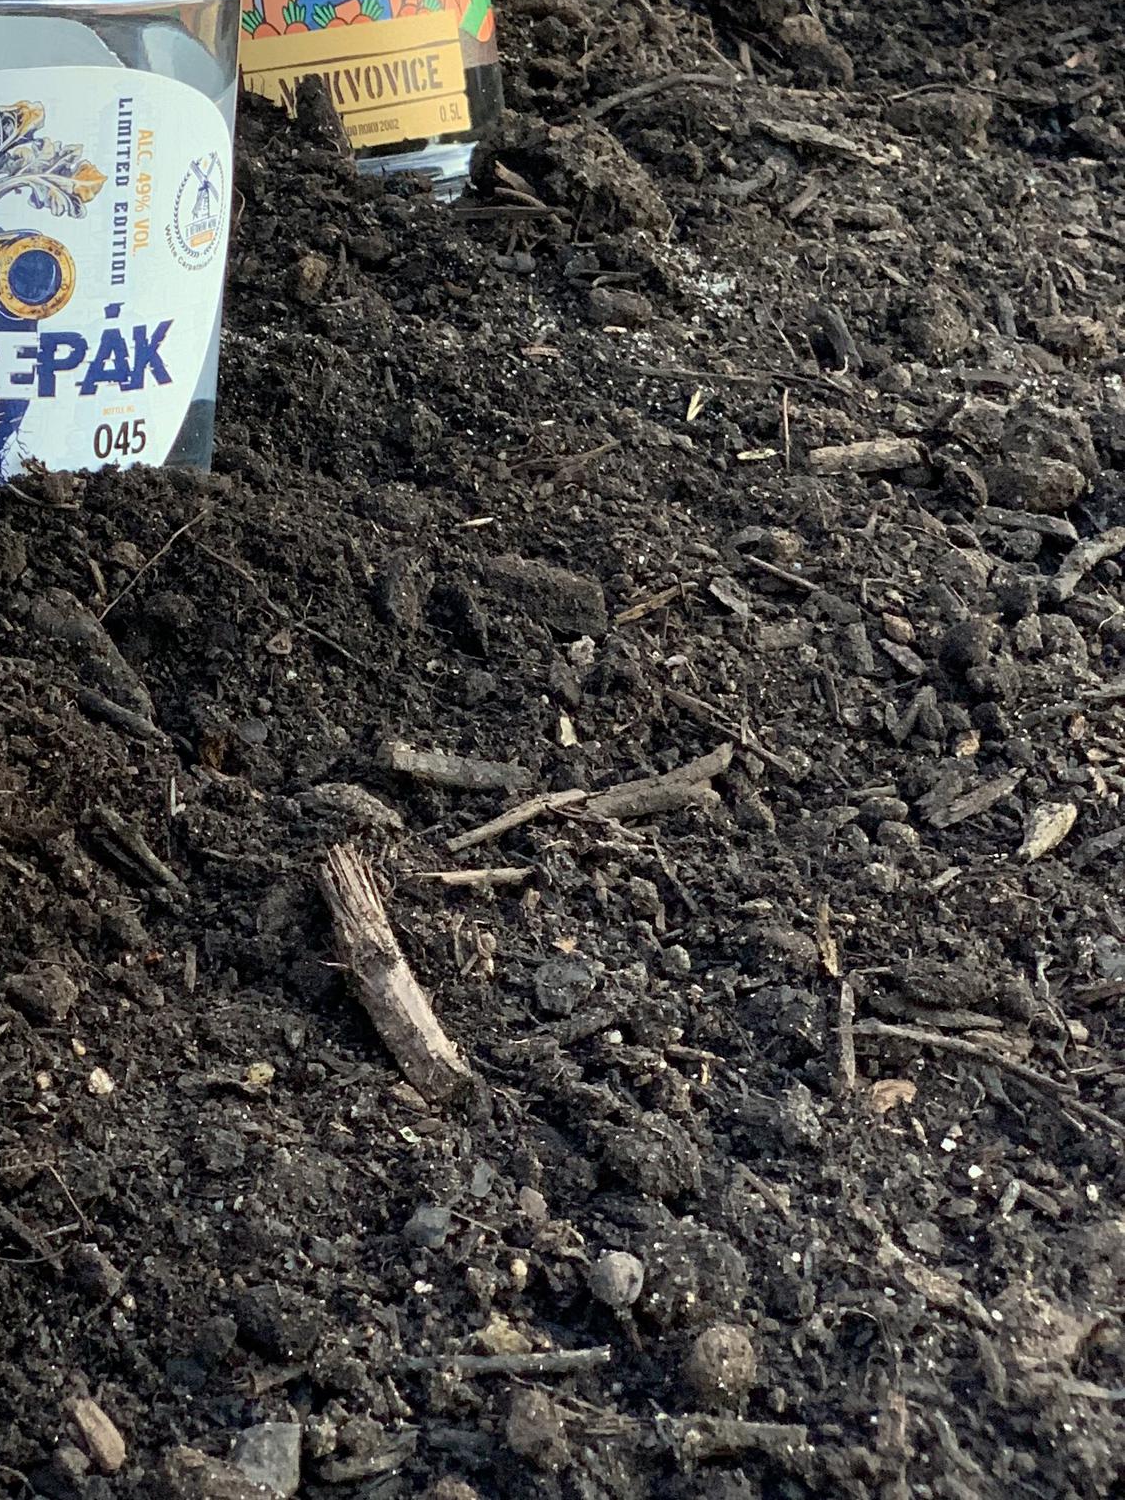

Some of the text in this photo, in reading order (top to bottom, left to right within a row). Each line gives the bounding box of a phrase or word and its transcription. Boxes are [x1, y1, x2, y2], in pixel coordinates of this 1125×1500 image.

[279, 54, 444, 112] MKVOVICE
[115, 97, 133, 188] LIMITED
[132, 128, 155, 257] ALC. 49% VOL.
[93, 419, 147, 459] 045
